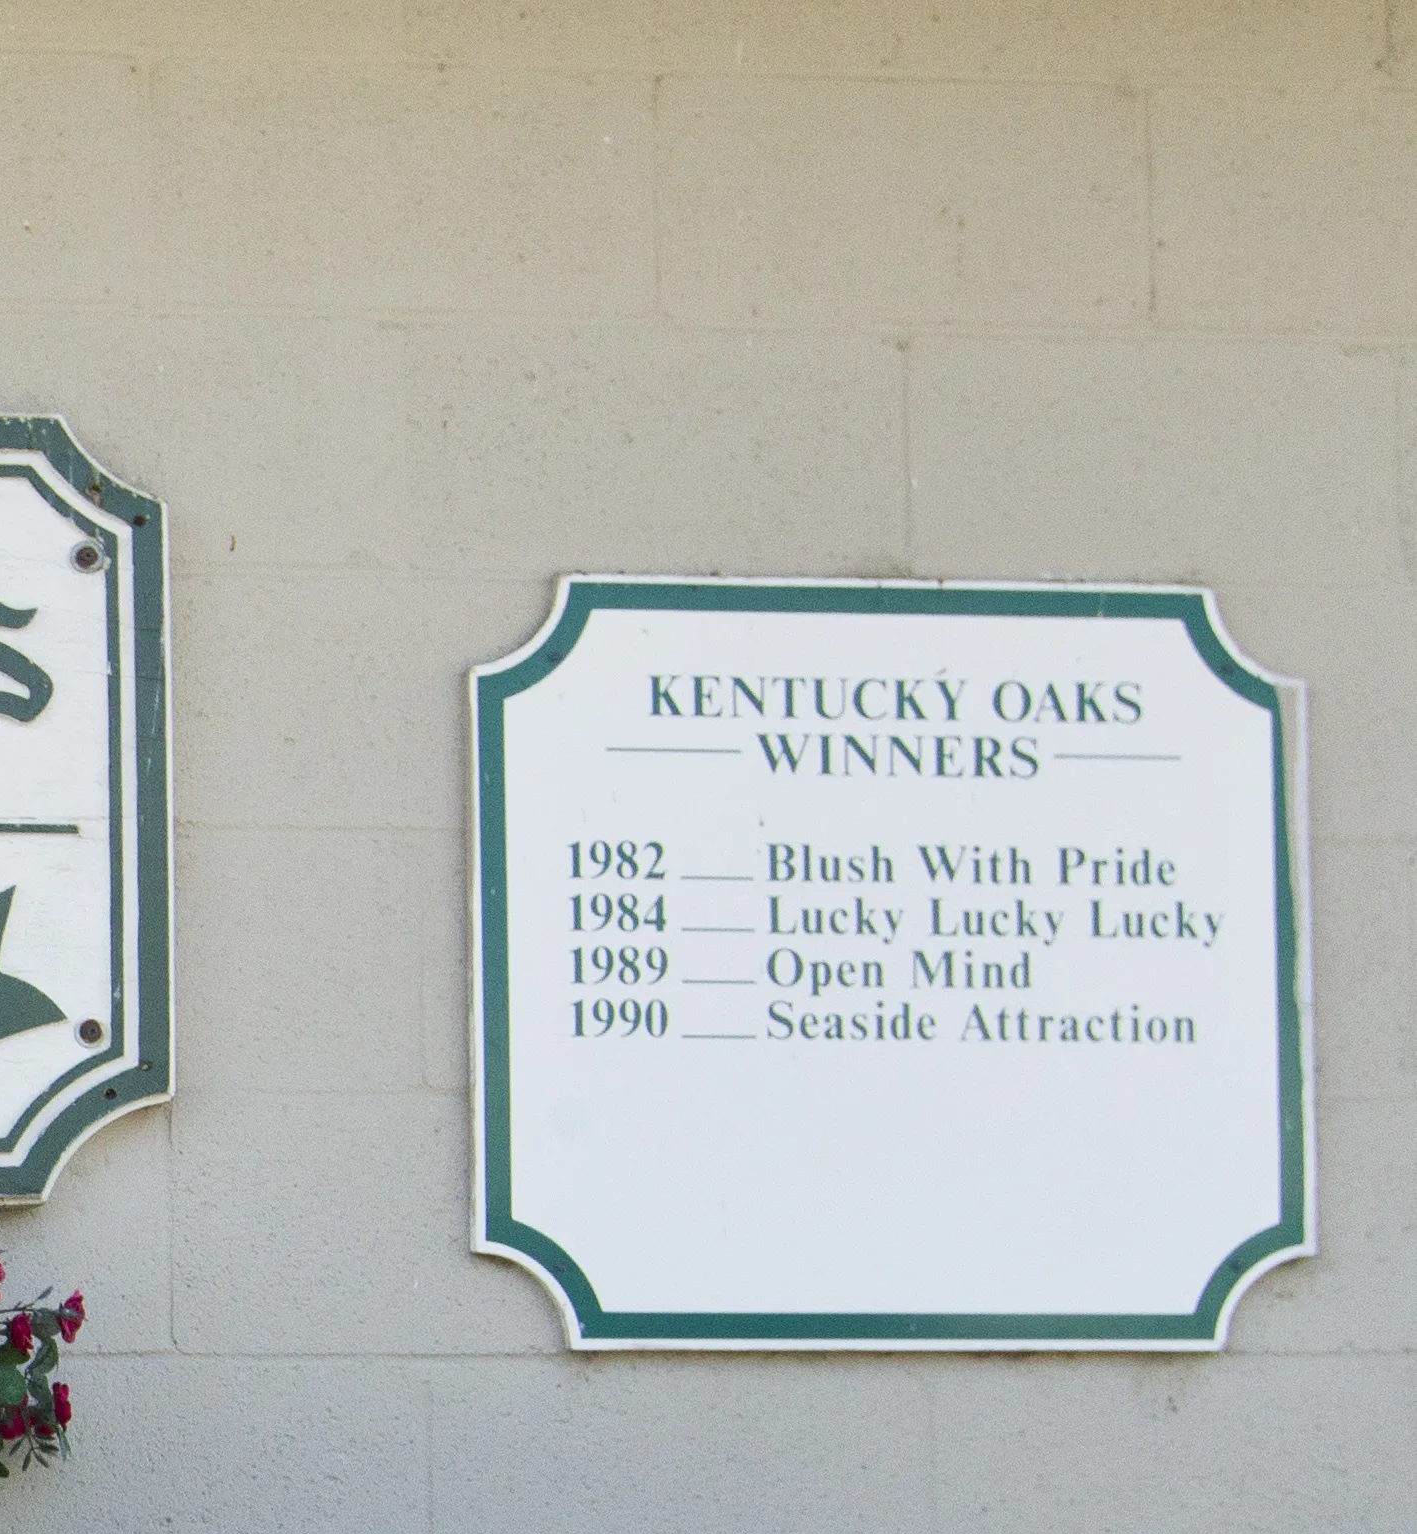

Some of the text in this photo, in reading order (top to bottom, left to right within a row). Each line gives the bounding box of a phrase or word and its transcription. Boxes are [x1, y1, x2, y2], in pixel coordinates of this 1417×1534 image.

[650, 675, 1142, 723] KENTUCKY OAKS
[757, 733, 1039, 778] WINNERS
[567, 840, 1176, 887] 1982 Blush With Pride
[571, 893, 1224, 948] 1984 Lucky Lucky Lucky
[572, 946, 1031, 997] 1989 Open Mind
[572, 999, 1195, 1043] 1990 Seaside Attraction
